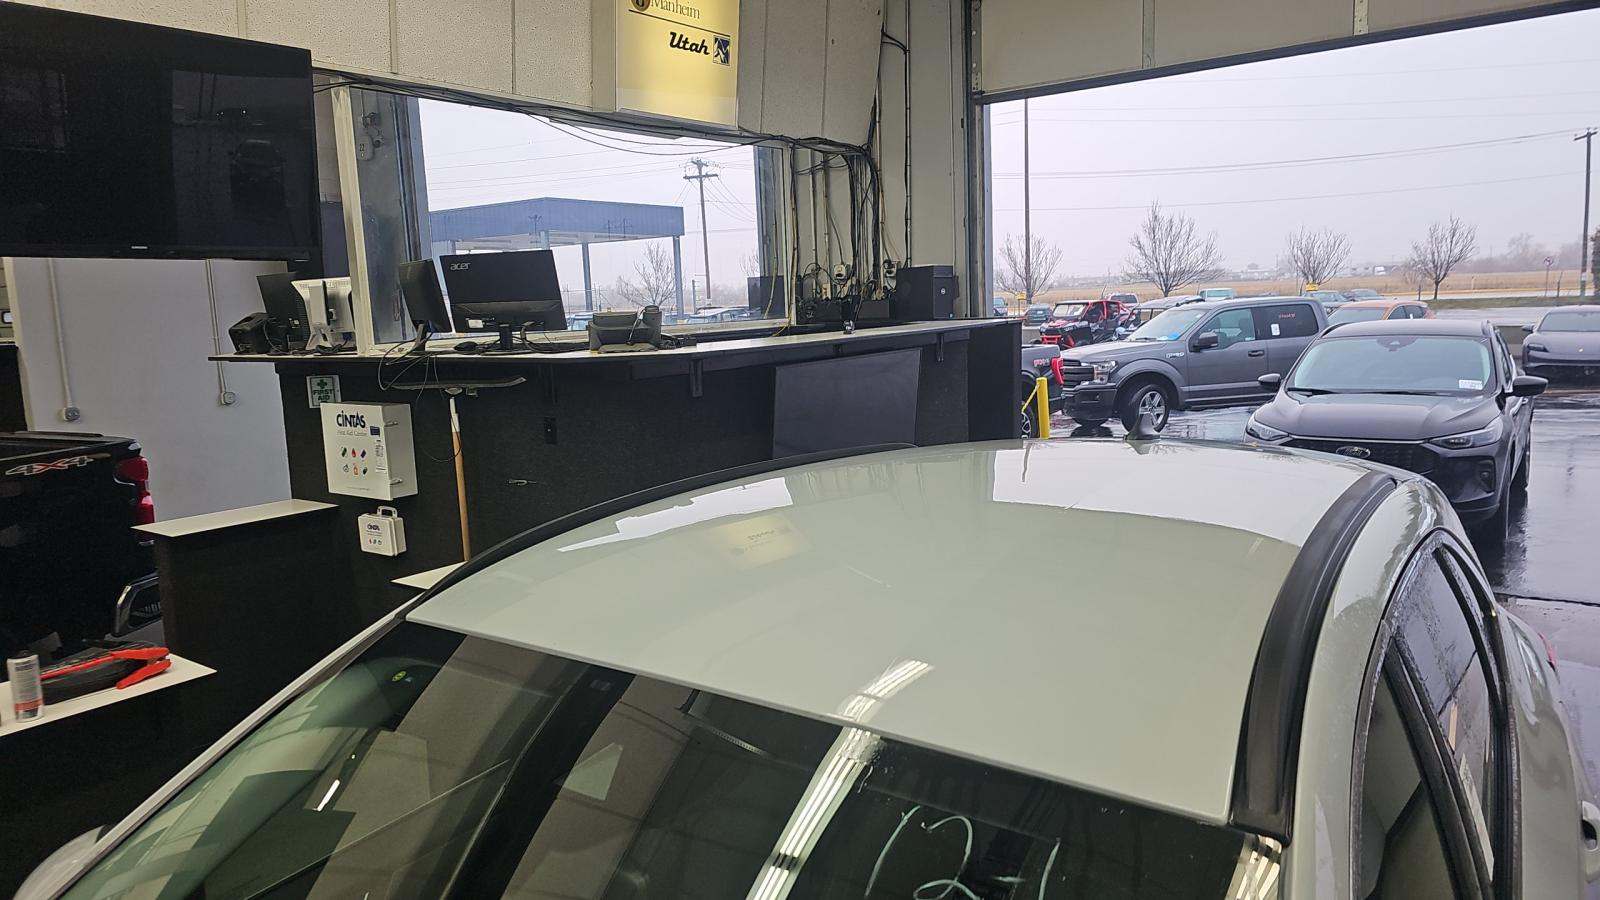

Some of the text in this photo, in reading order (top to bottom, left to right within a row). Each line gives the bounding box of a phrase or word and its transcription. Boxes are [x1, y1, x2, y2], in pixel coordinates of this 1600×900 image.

[651, 0, 700, 19] Manheim
[669, 31, 710, 55] Utah
[450, 262, 471, 270] acer
[336, 410, 366, 429] CINTAS
